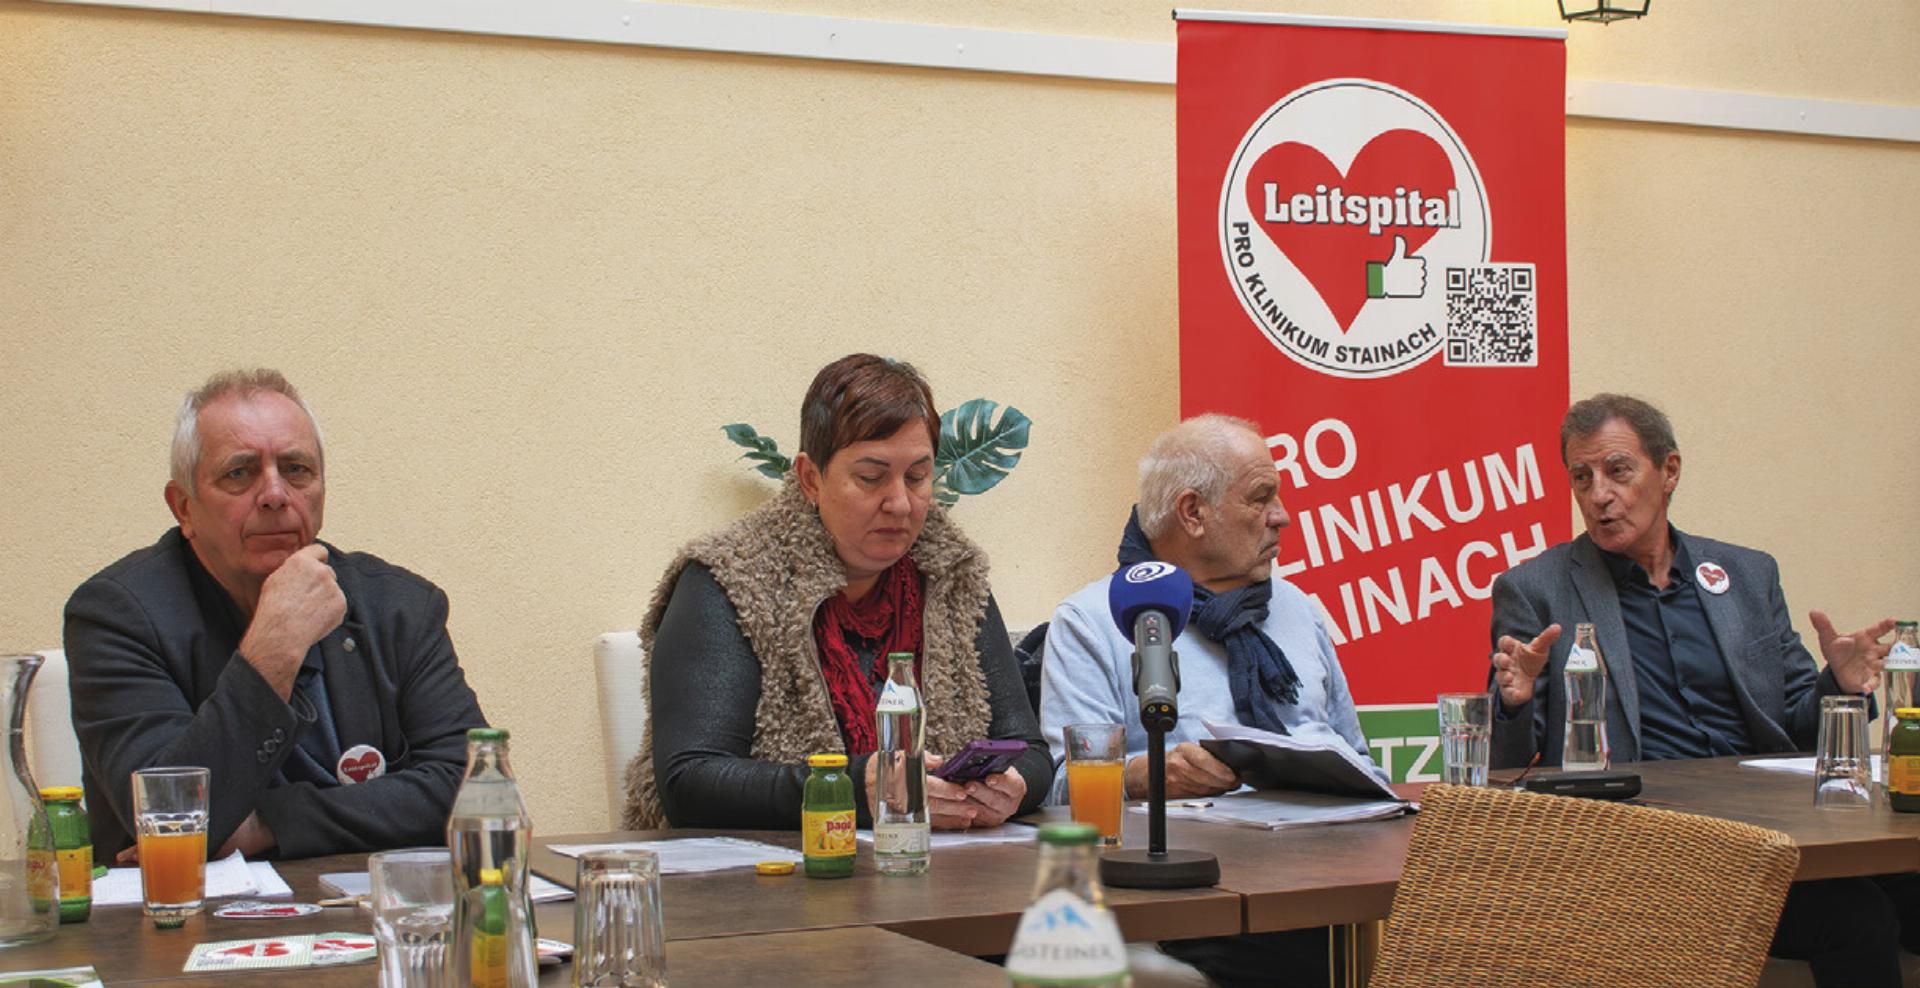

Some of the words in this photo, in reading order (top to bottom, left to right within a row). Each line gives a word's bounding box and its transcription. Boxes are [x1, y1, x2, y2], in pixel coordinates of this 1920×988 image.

[1262, 181, 1461, 236] Leitspital
[1233, 222, 1255, 268] PRO
[1245, 272, 1330, 359] KLINIKUM
[1335, 322, 1437, 365] STAINACH
[1264, 418, 1358, 489] RO
[1270, 443, 1546, 578] LINIKUM
[1369, 735, 1441, 783] TZ
